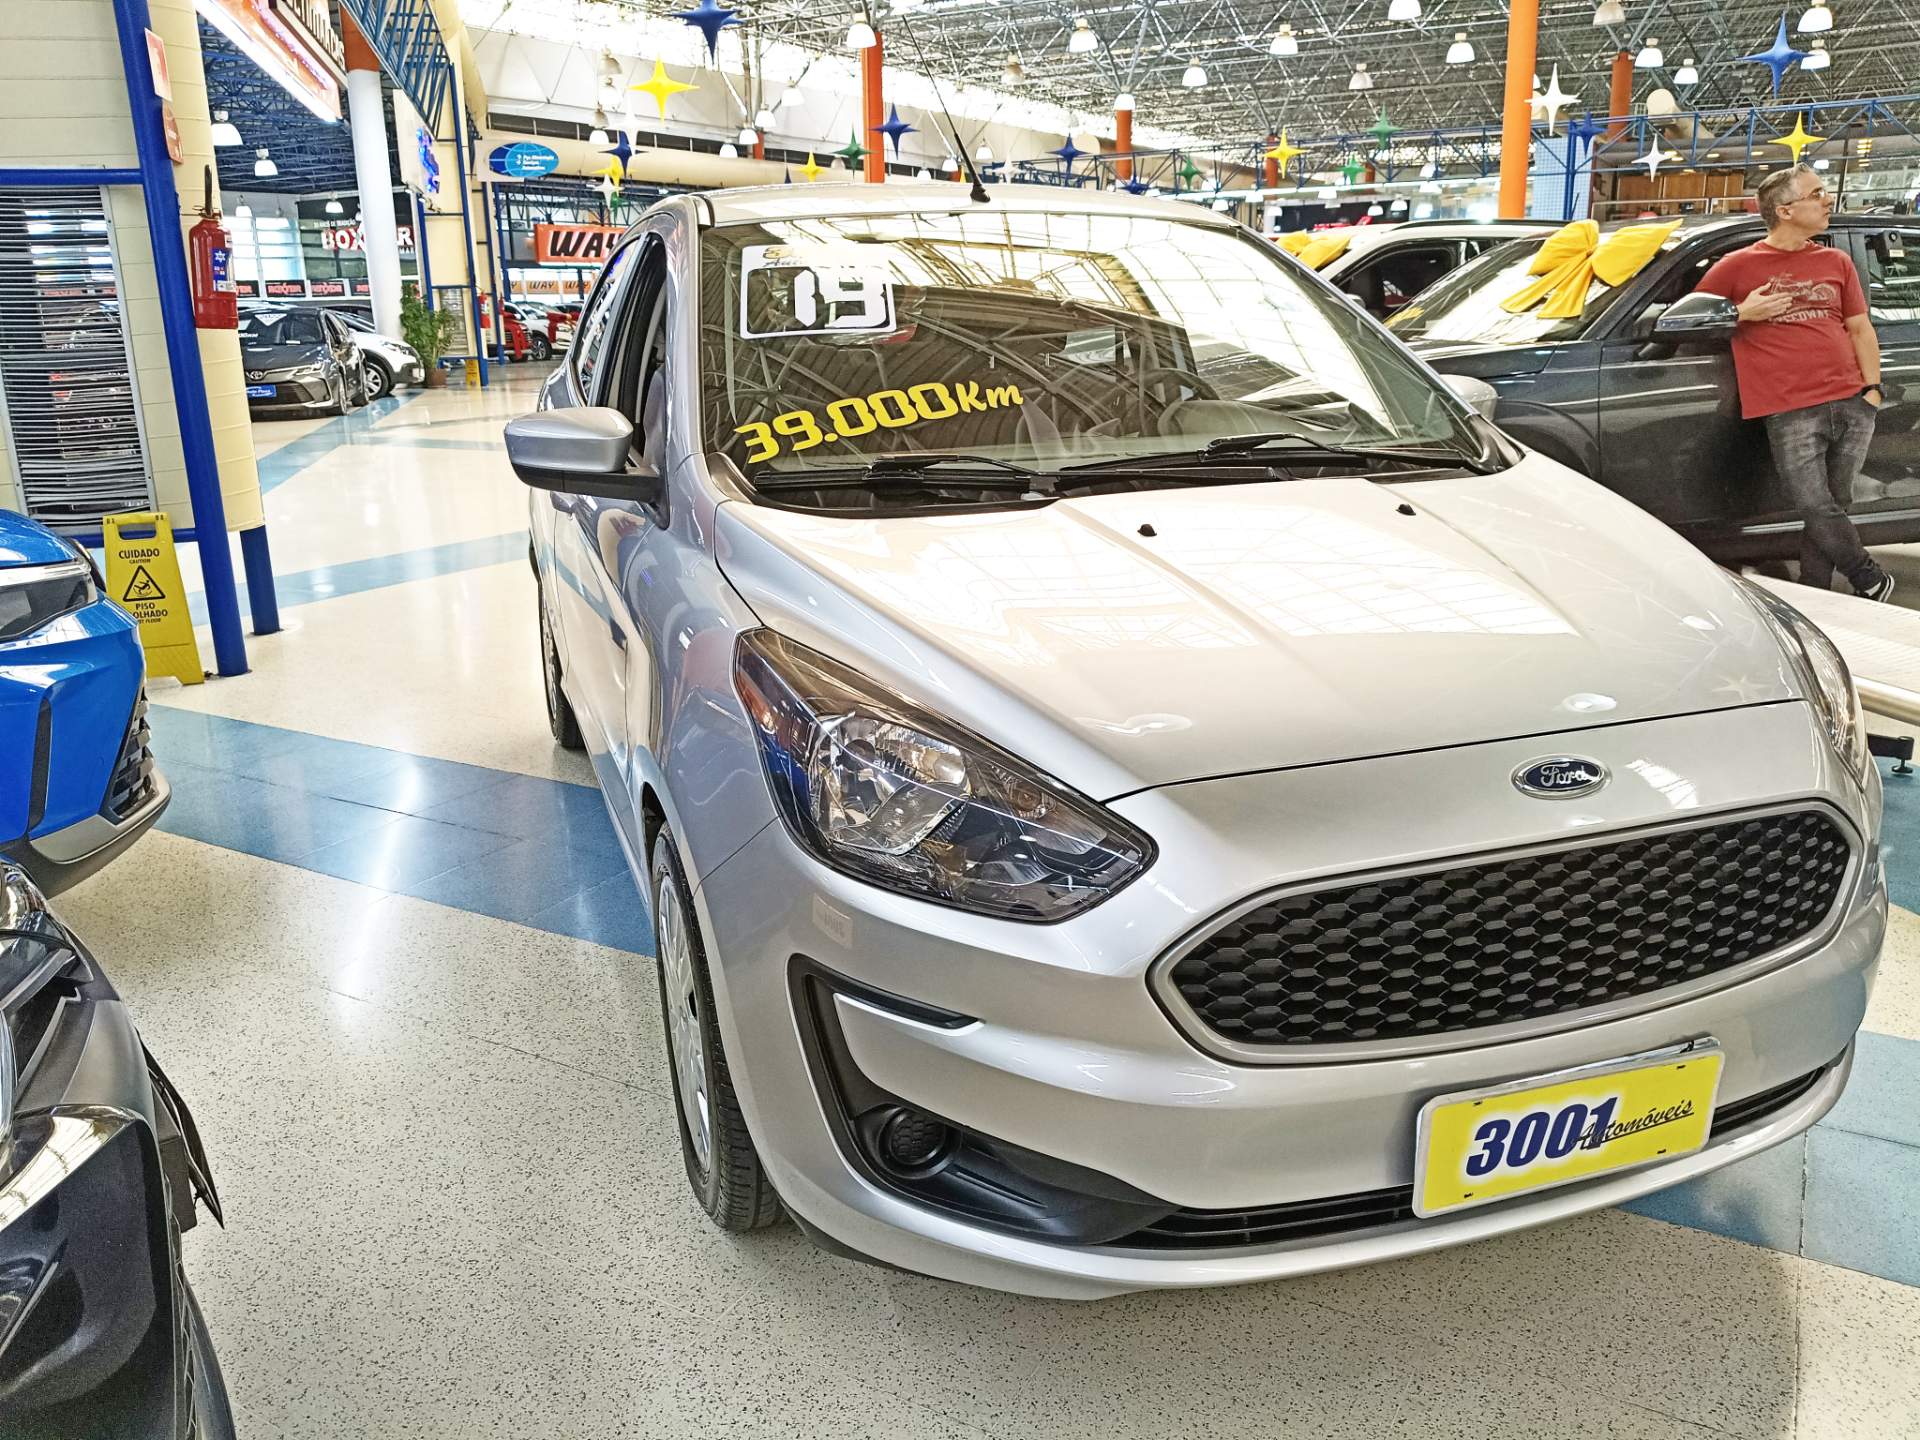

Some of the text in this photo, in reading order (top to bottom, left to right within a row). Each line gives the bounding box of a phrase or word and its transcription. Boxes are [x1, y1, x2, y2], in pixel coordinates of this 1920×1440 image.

[321, 226, 413, 251] BOXR
[529, 281, 554, 290] WAY
[564, 281, 592, 290] WY
[118, 548, 160, 559] CUIDADO
[135, 602, 155, 610] PISO
[132, 609, 168, 619] OLHADO
[1540, 762, 1599, 787] Ford
[1465, 1097, 1694, 1177] 3001 Automóveis
